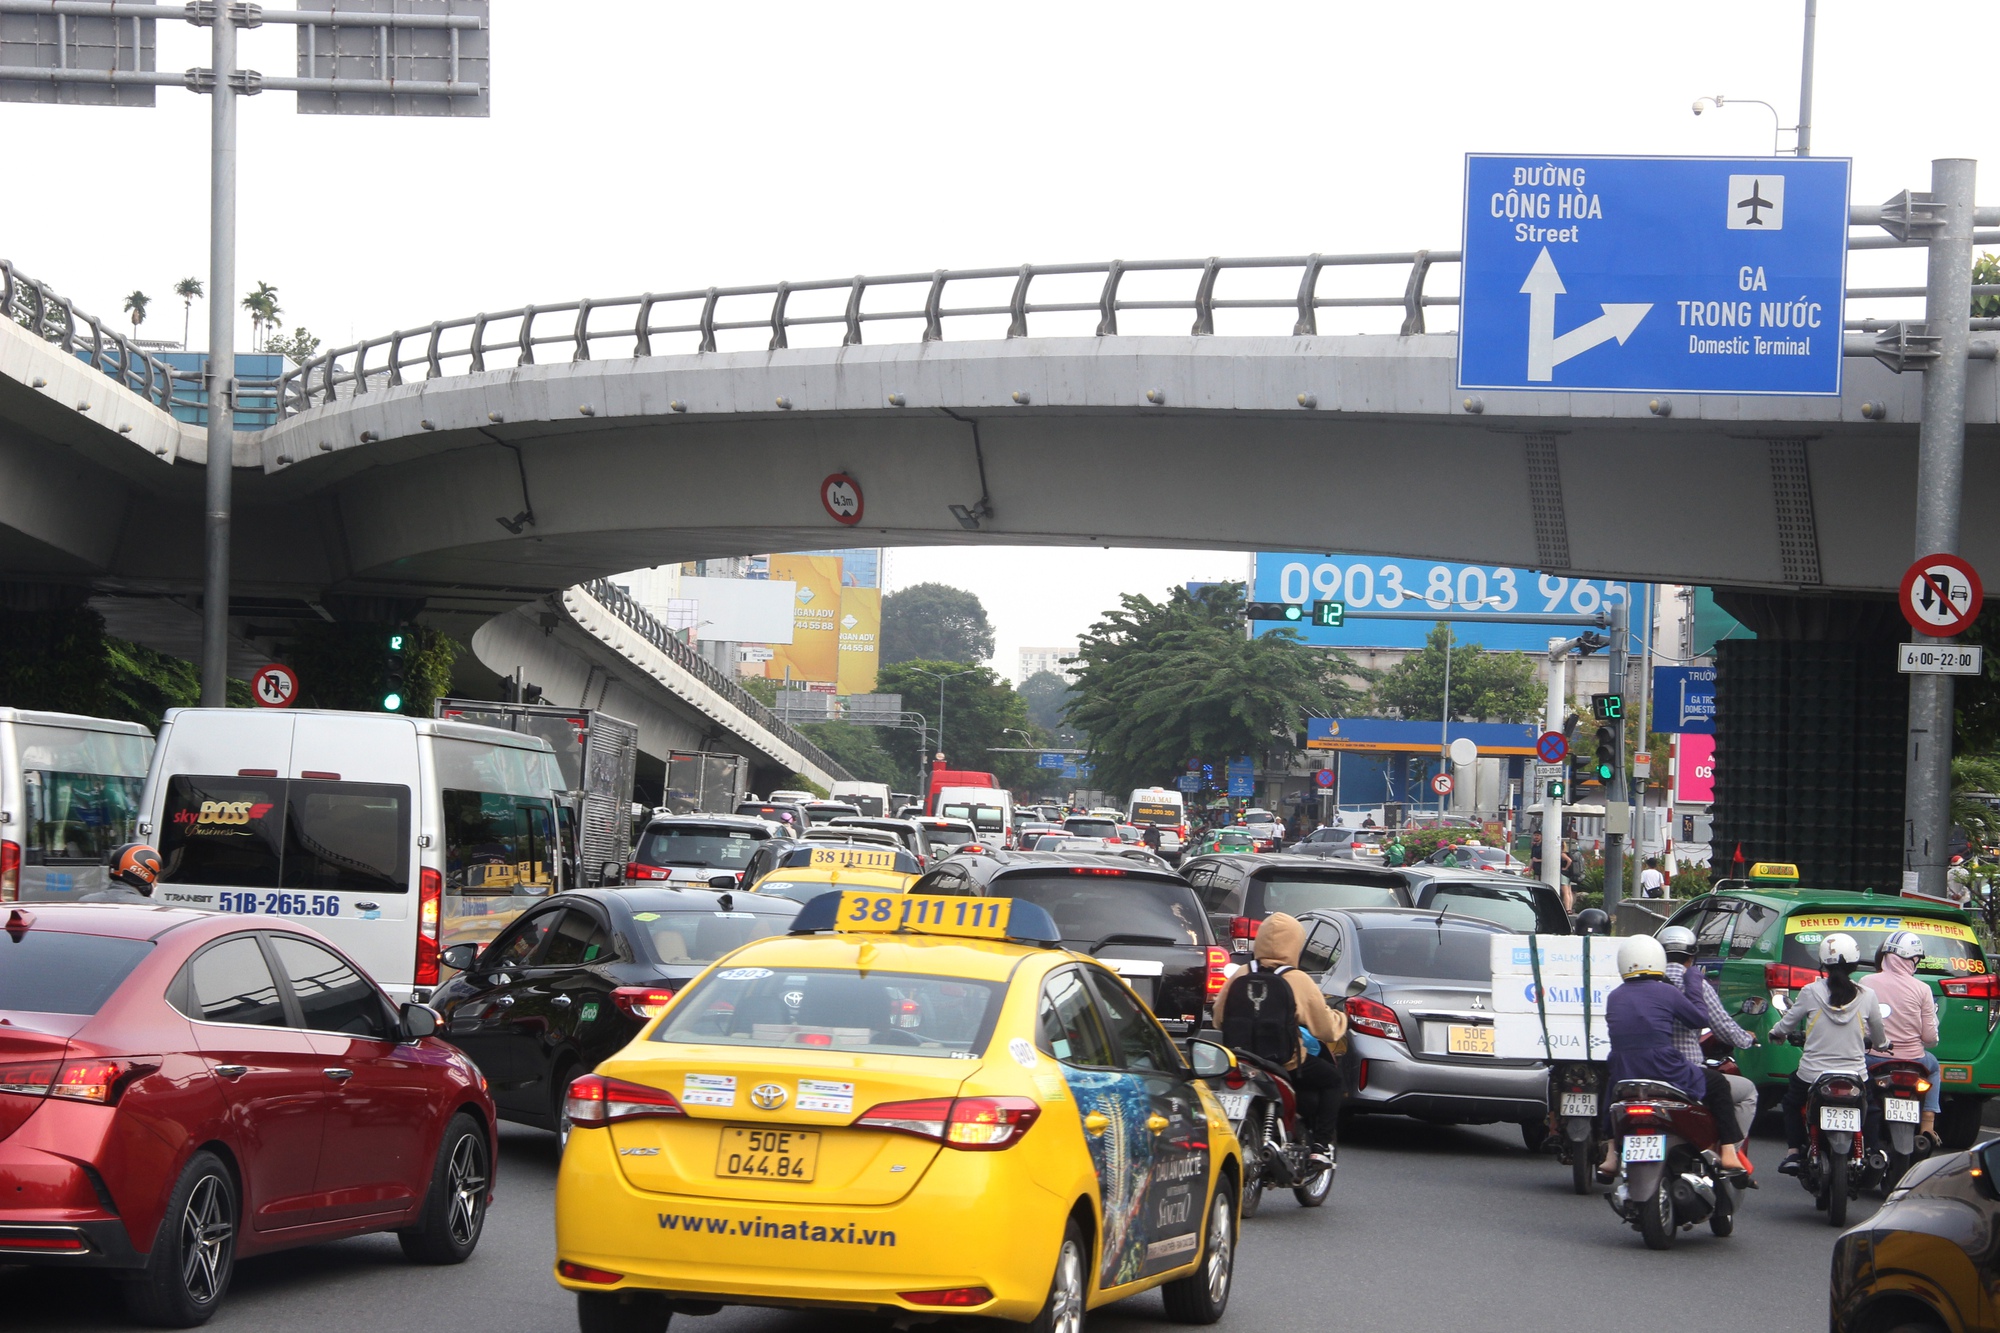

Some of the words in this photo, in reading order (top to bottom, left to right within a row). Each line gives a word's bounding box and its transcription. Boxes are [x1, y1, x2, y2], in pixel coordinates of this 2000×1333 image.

[1512, 162, 1586, 187] ĐƯỜNG
[1490, 188, 1551, 222] CỘNG
[1558, 187, 1603, 219] HÒA
[1515, 222, 1579, 243] Street
[1738, 265, 1768, 292] GA
[1677, 300, 1752, 328] TRONG
[1759, 295, 1822, 328] NƯỚC
[1689, 334, 1750, 355] Domestic
[1753, 335, 1811, 356] Terminal
[1280, 561, 1403, 609] 0903
[1424, 566, 1518, 612] 803
[816, 609, 834, 618] ADV
[1321, 603, 1341, 626] 12
[809, 622, 821, 630] 55
[821, 622, 834, 631] 88
[858, 633, 875, 641] ADV
[852, 644, 864, 652] 55
[863, 644, 875, 652] 88
[1907, 652, 1972, 667] 6:00-22:00
[1690, 695, 1701, 704] GA
[1604, 696, 1621, 718] 12
[1158, 796, 1172, 804] MAI
[184, 823, 238, 837] Business
[814, 850, 836, 864] 38
[839, 851, 864, 865] 111
[866, 853, 891, 867] 111
[164, 893, 213, 903] TRANSIT
[219, 891, 340, 917] 51B-265.56
[849, 897, 892, 922] 38
[901, 899, 946, 925] 111
[955, 901, 1000, 928] 111
[1800, 916, 1821, 928] ĐÈN
[1822, 918, 1840, 927] LED
[1843, 916, 1902, 929] MPE
[1905, 919, 1931, 931] THIẾT
[1933, 924, 1943, 934] BỊ
[1944, 925, 1965, 937] ĐIỆN
[1799, 934, 1822, 943] 5638
[1949, 957, 1986, 974] 1055
[722, 968, 767, 980] 3903
[581, 1005, 598, 1019] Grab
[1464, 1028, 1487, 1040] 50E
[1537, 1034, 1581, 1049] AQUA
[1562, 1104, 1596, 1115] 784.76
[1826, 1108, 1854, 1120] 52-S6
[1886, 1110, 1918, 1122] 054.93
[1826, 1118, 1855, 1130] 7434
[749, 1131, 792, 1153] 50E
[1629, 1137, 1658, 1148] 59-P2
[619, 1147, 661, 1156] VIOS
[1625, 1149, 1661, 1160] 827.44
[728, 1153, 804, 1177] 044.84
[657, 1212, 897, 1247] www.vinataxi.vn
